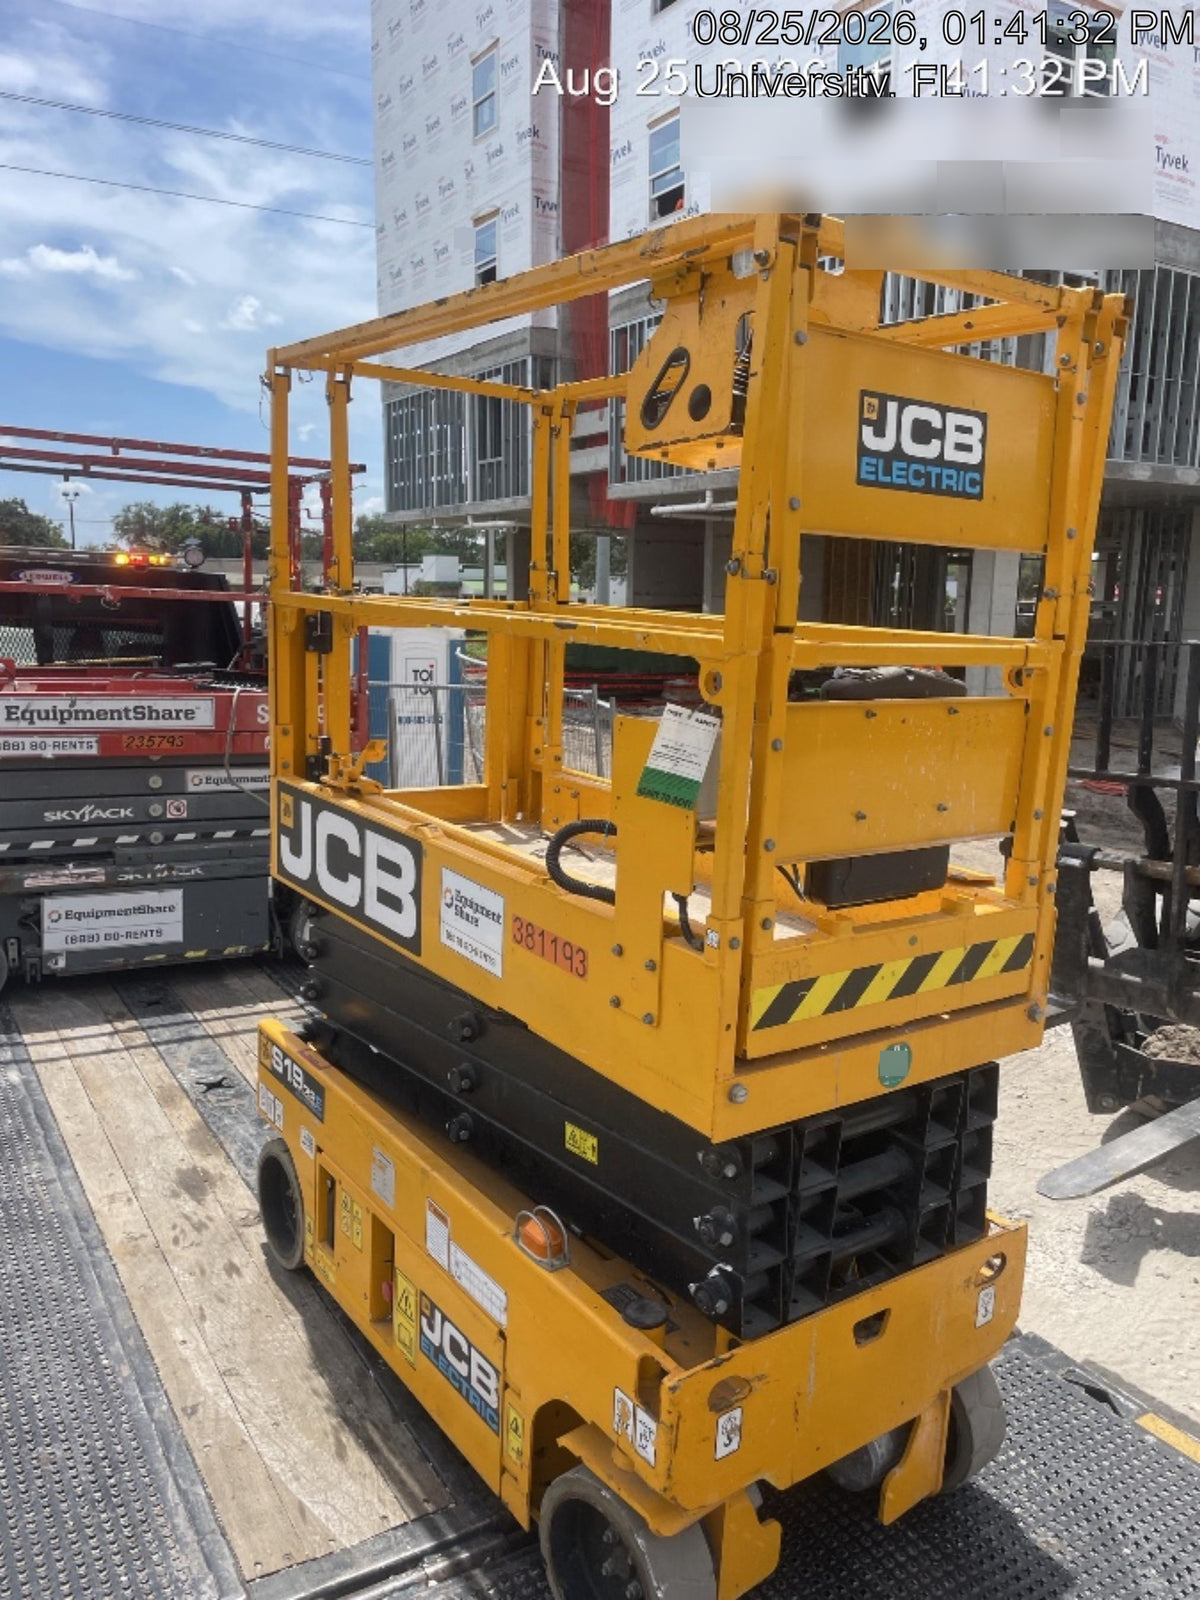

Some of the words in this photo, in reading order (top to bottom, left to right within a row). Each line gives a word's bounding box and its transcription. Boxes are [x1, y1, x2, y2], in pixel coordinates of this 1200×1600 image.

[1155, 145, 1189, 173] Tyvek
[861, 401, 984, 465] JCB
[860, 456, 981, 494] ELECTRIC
[5, 704, 196, 726] EquipmentShare
[29, 740, 94, 751] 80-RENTS
[44, 805, 134, 822] SKYJACK
[279, 800, 417, 939] JCB
[64, 904, 176, 920] EquipmentShare
[512, 916, 586, 978] 381193
[421, 1309, 499, 1409] JCB
[421, 1336, 498, 1427] ELECTRIC
